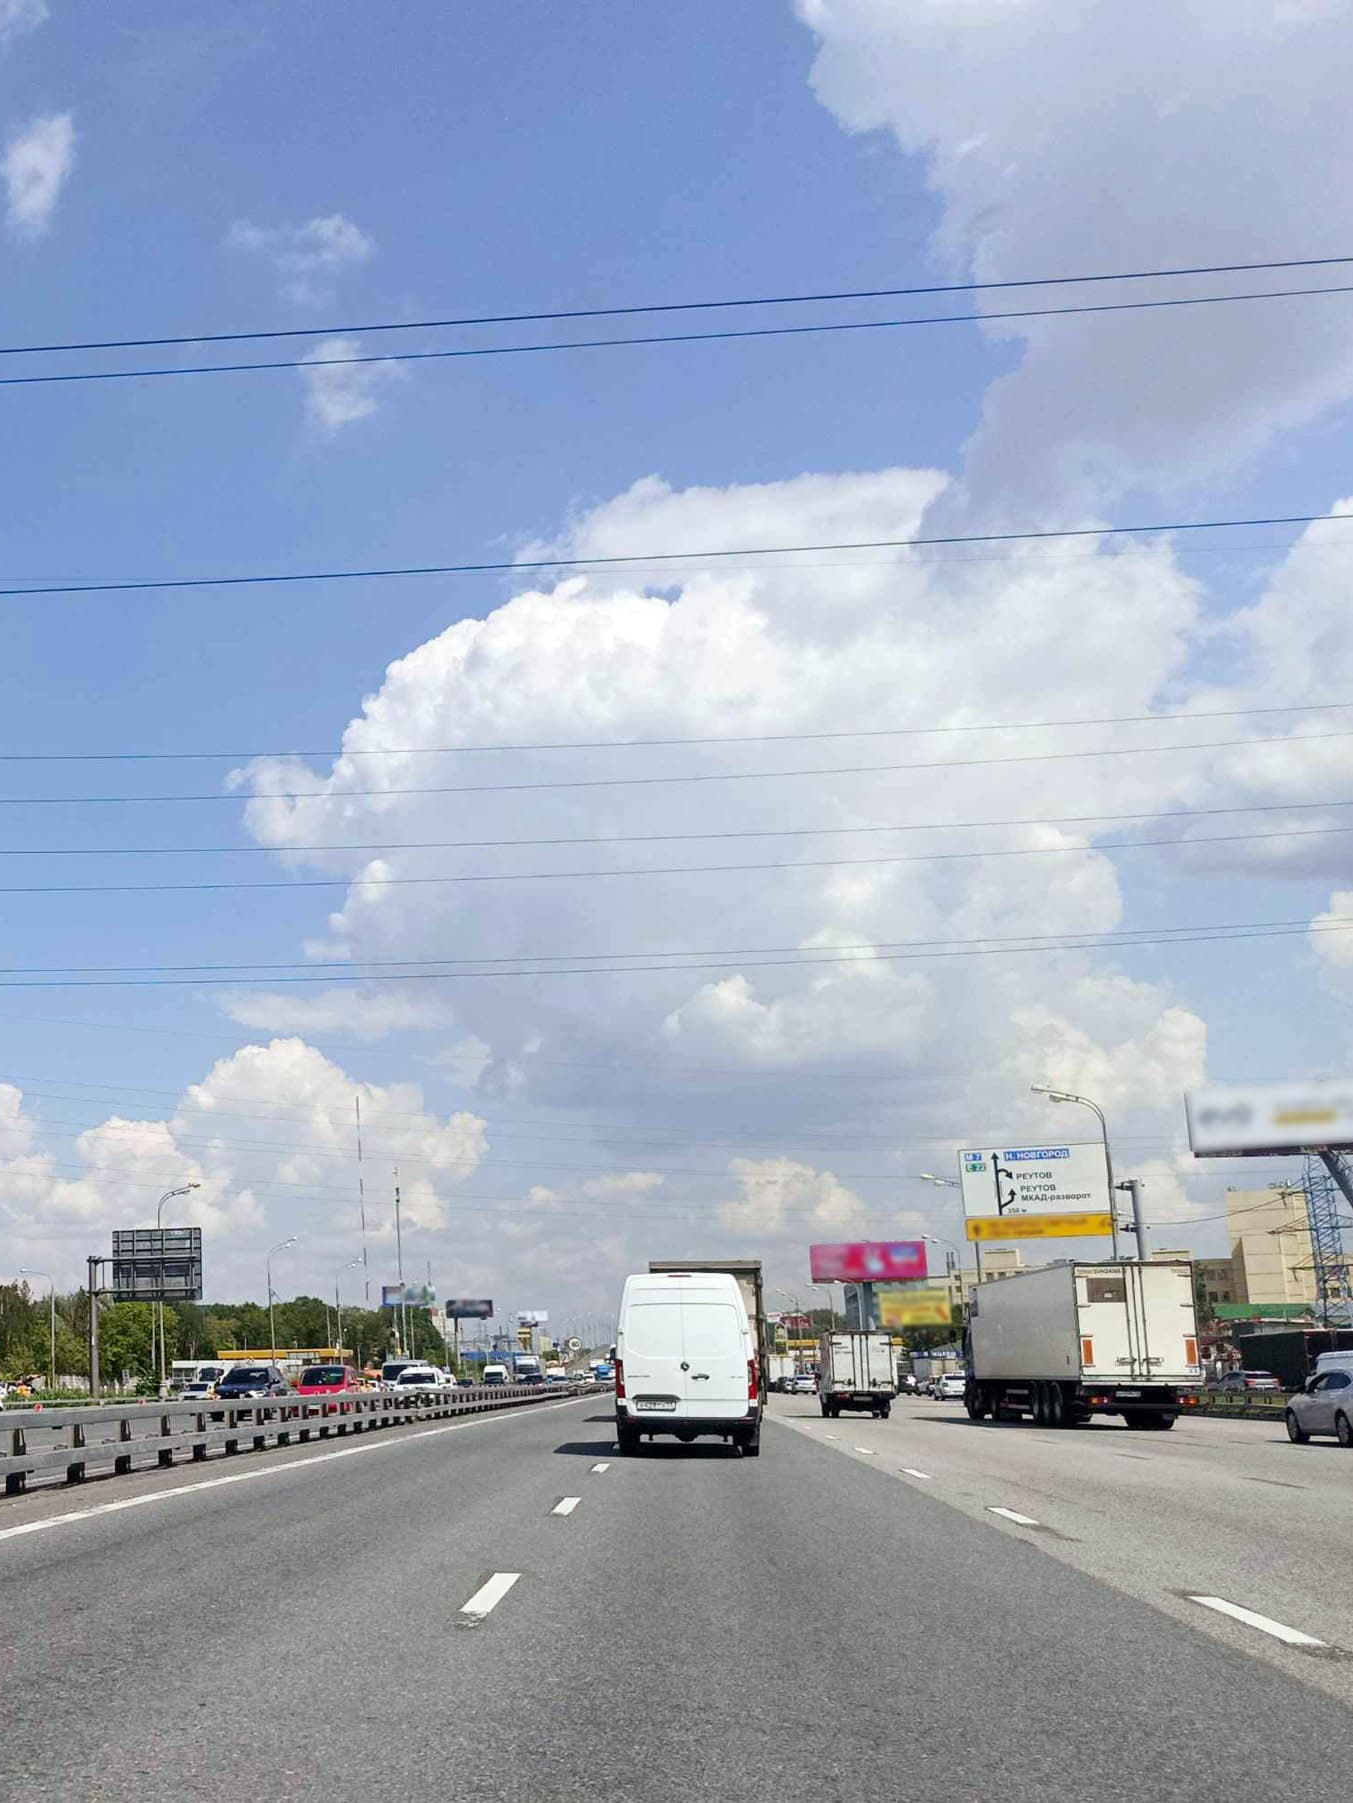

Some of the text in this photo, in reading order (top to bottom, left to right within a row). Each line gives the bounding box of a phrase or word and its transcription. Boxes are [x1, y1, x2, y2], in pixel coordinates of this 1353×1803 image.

[1017, 1150, 1068, 1160] НОВГОРОД
[1016, 1172, 1052, 1180] РЕУТОВ
[1020, 1184, 1057, 1192] РЕУТОВ
[1021, 1193, 1091, 1201] МКАД-разворот
